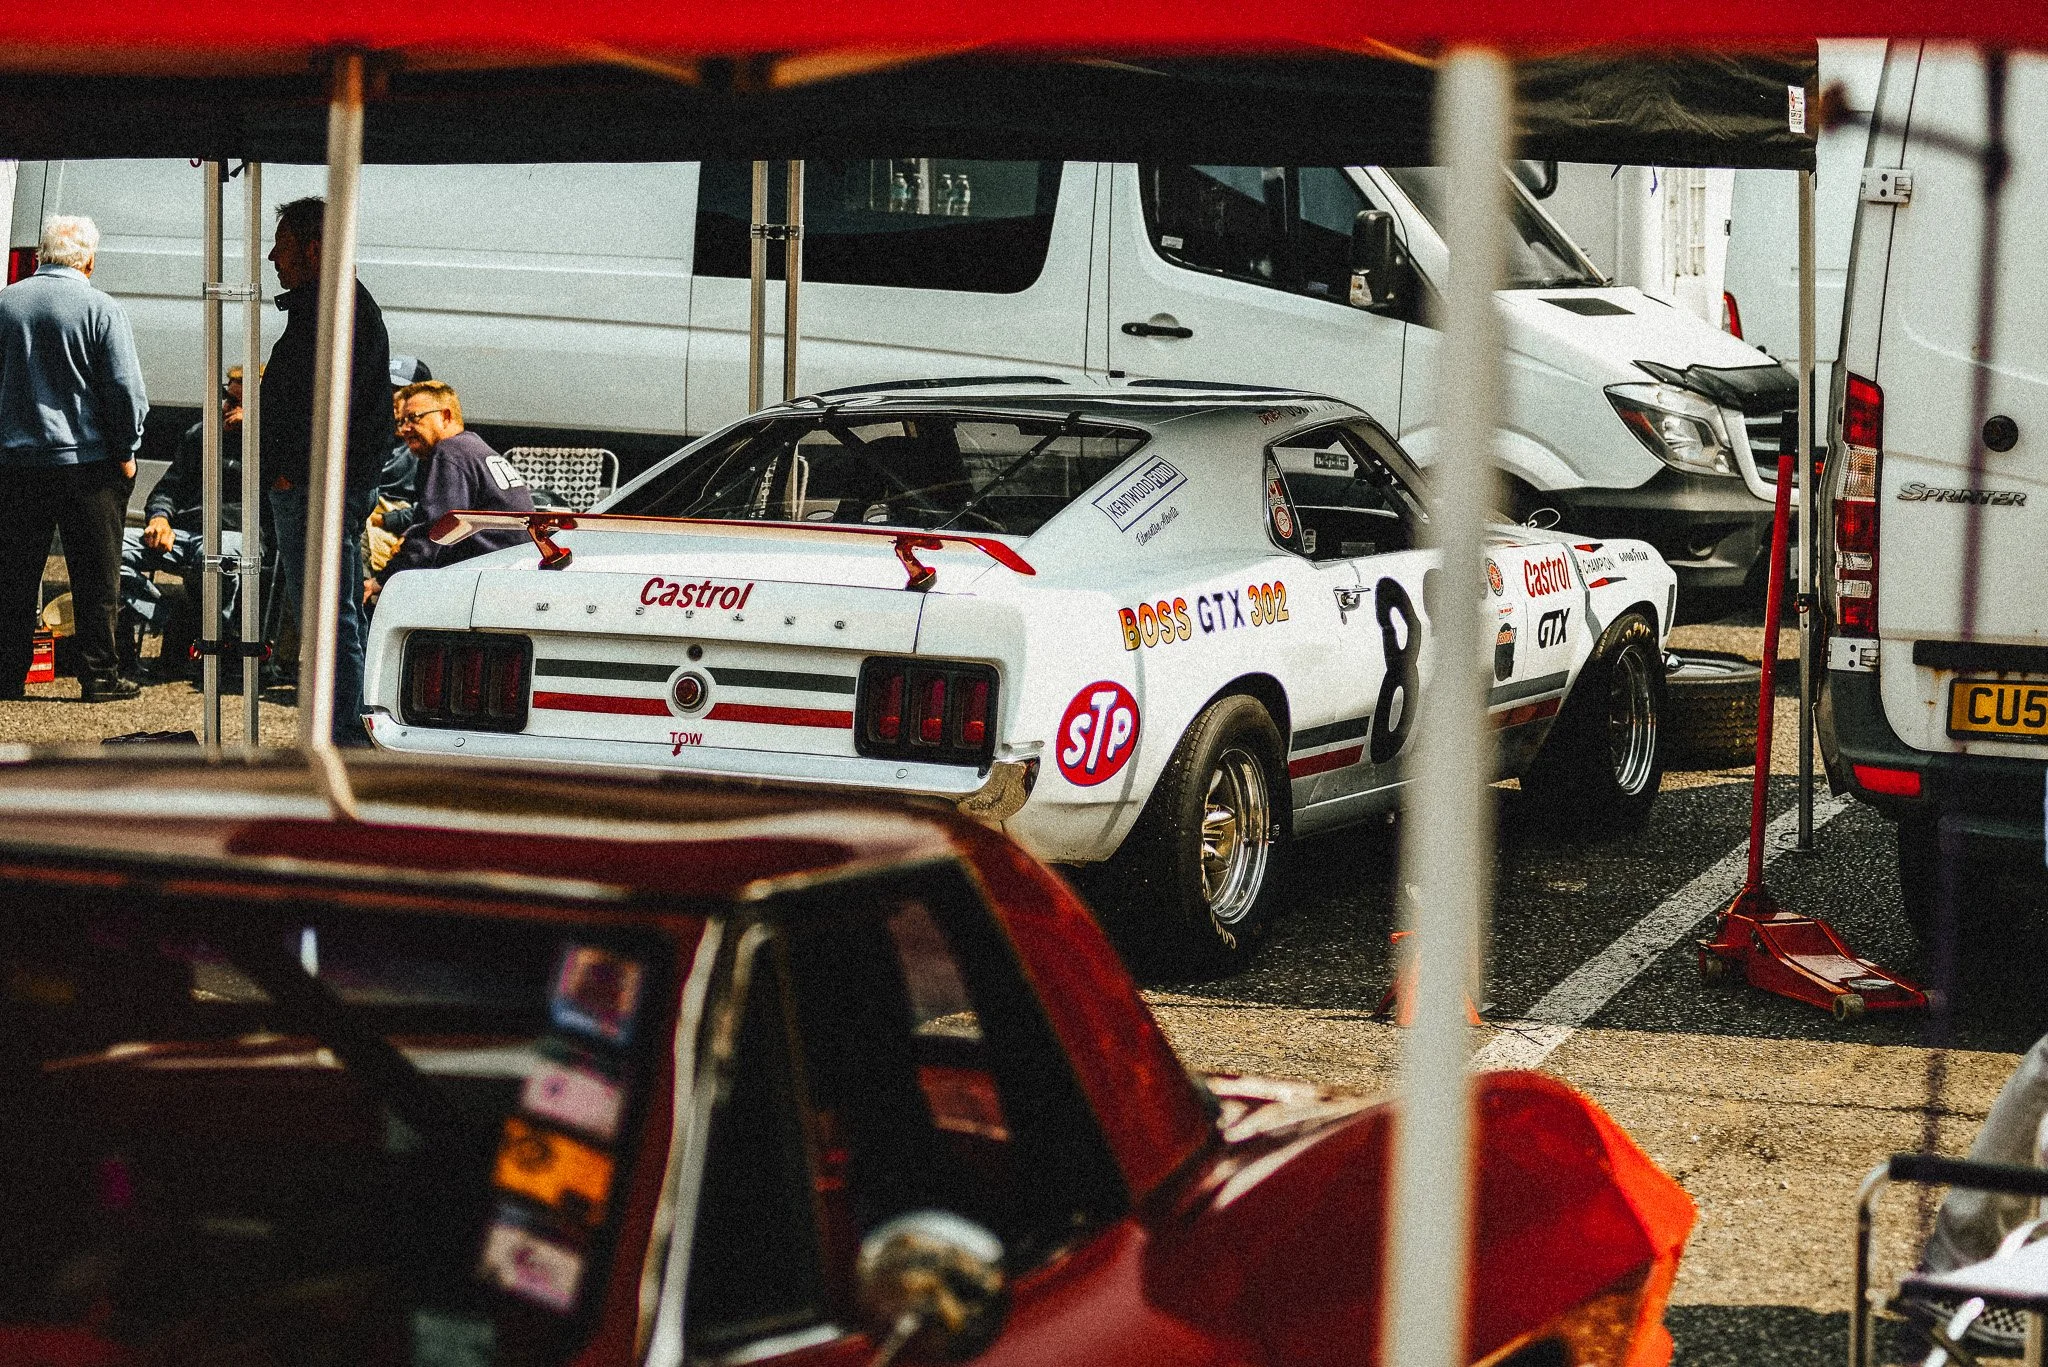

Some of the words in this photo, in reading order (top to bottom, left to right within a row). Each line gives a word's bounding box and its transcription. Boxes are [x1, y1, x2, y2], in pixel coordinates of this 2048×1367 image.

[1106, 478, 1156, 520] KENTWOOD
[1145, 463, 1175, 489] FORD
[1896, 482, 2028, 507] SPRINTER
[1523, 552, 1572, 598] Castrol
[1582, 556, 1616, 576] CHAMPION
[1618, 550, 1650, 563] GOODYEAR
[640, 576, 755, 610] Castrol
[1118, 597, 1192, 651] BOSS
[1196, 589, 1246, 636] GTX
[1247, 580, 1290, 627] 302
[1537, 607, 1571, 649] GTX
[1967, 686, 2048, 729] CU5
[669, 731, 703, 746] TOW
[1062, 690, 1133, 775] STP
